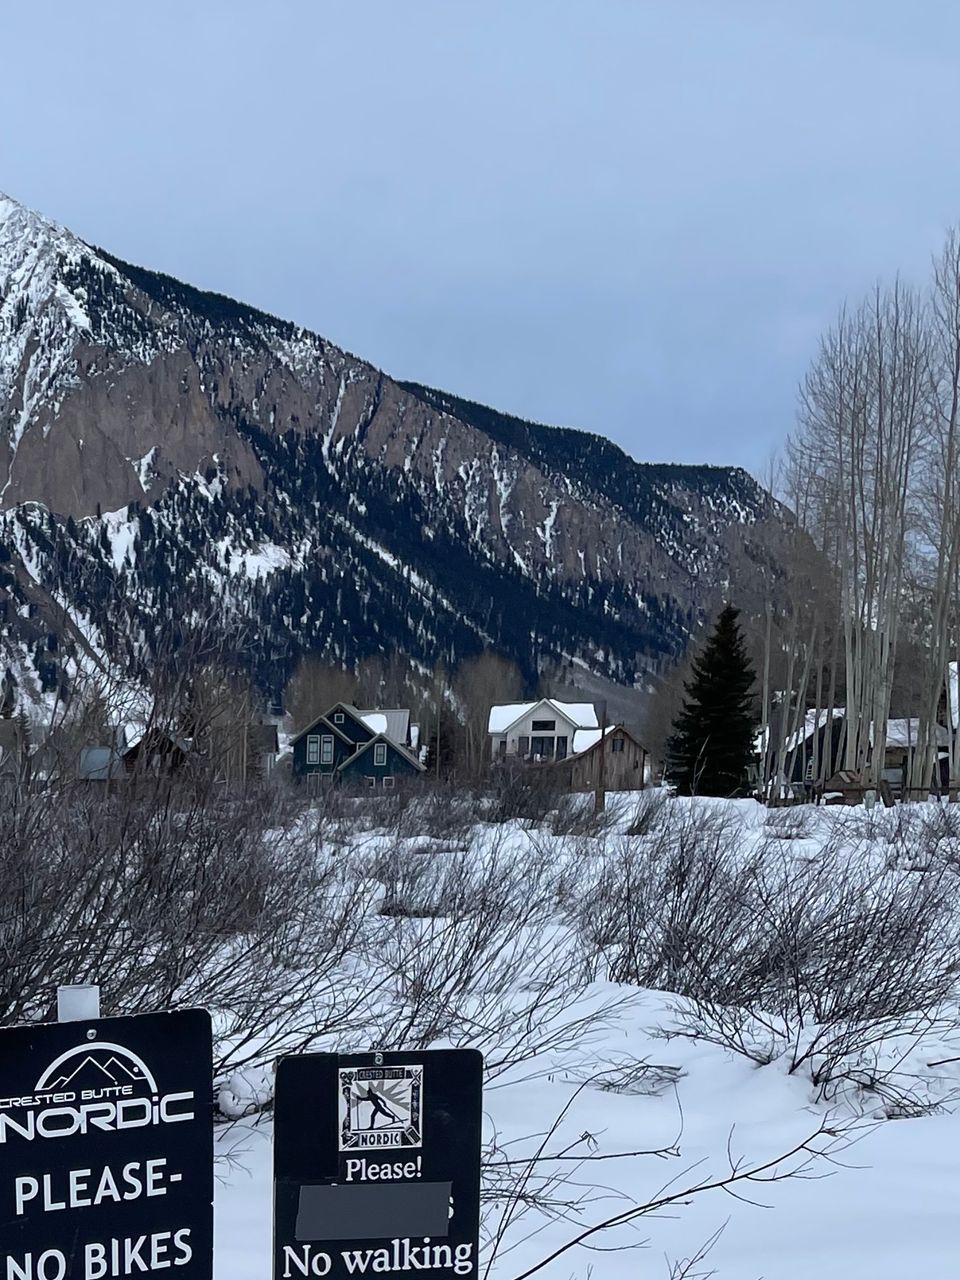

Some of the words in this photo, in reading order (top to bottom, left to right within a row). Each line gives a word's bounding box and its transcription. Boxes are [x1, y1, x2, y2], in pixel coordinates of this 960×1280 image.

[81, 1085, 133, 1100] BUTTE
[361, 1133, 399, 1146] NORDIC
[345, 1156, 423, 1181] Please!
[15, 1158, 183, 1215] PLEASE-
[85, 1228, 192, 1280] BIKES
[282, 1244, 332, 1278] No
[341, 1237, 473, 1275] walking
